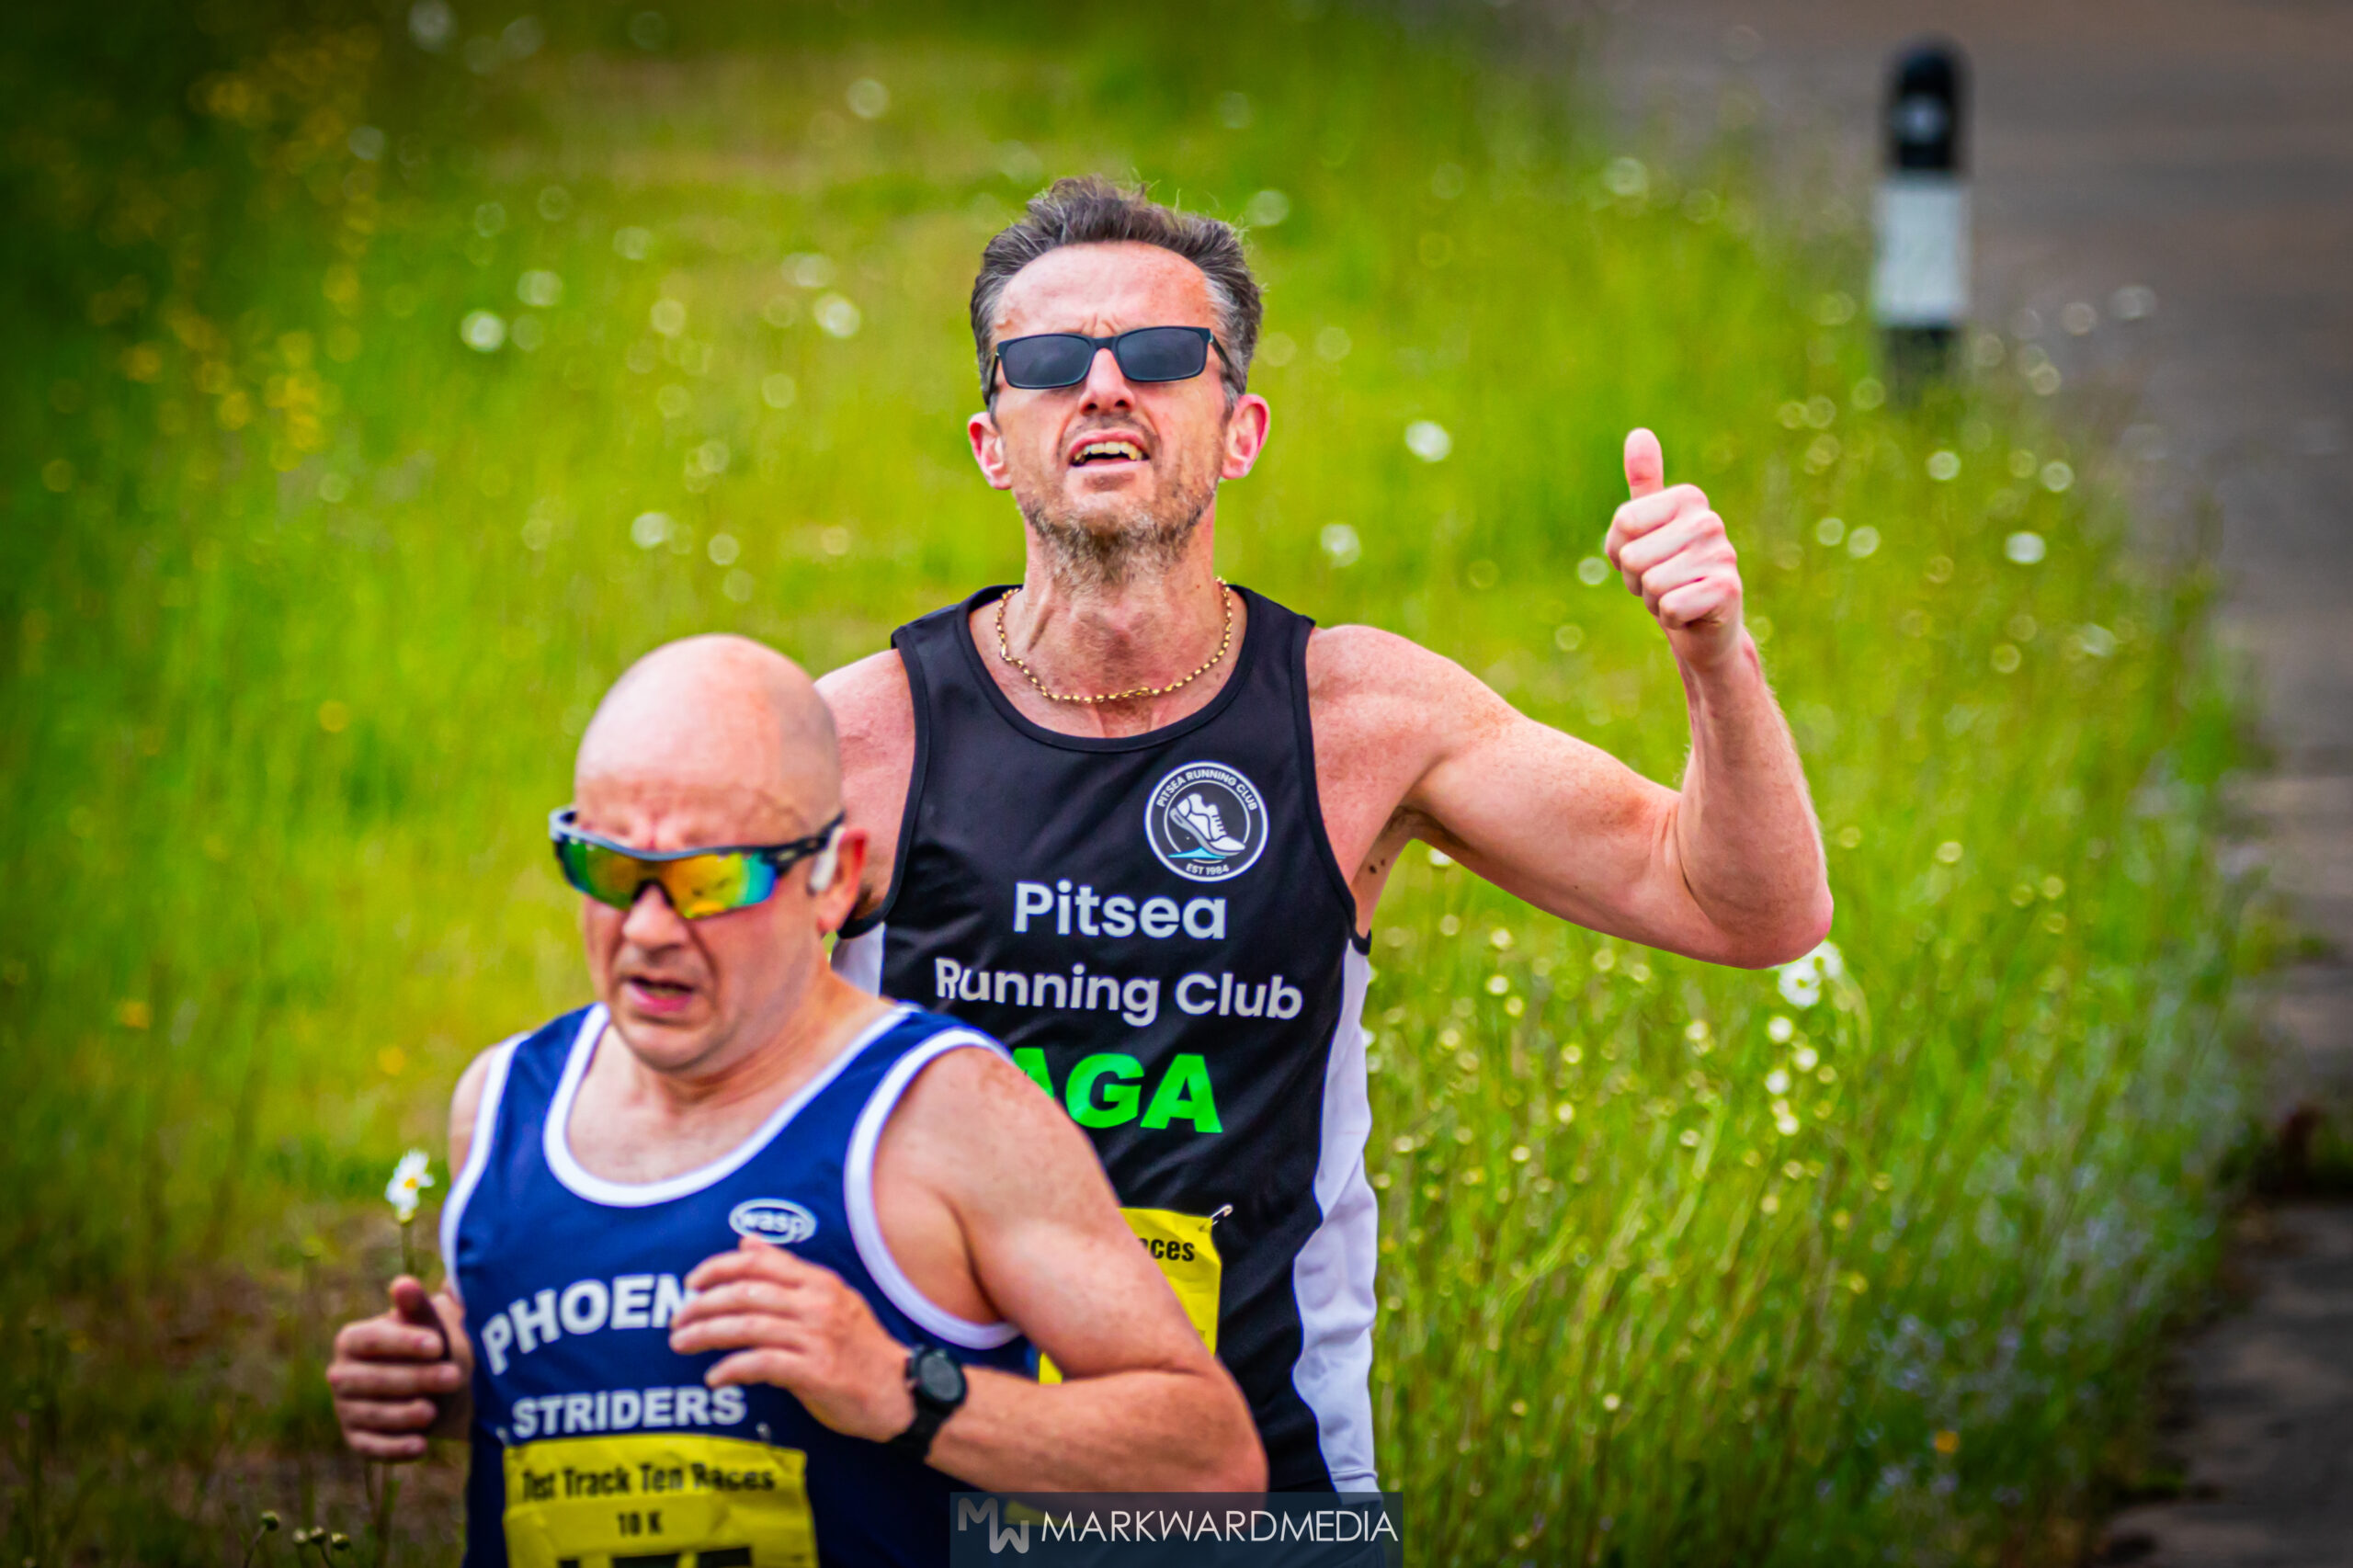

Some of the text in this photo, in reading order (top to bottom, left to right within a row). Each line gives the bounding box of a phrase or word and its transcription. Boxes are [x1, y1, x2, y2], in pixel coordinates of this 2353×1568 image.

[1156, 768, 1258, 811] PITSEA RUNNING CLUB
[1186, 863, 1230, 876] EST 1984
[1014, 880, 1227, 939] Pitsea
[935, 958, 1302, 1027] Running Club
[481, 1274, 697, 1376] PHOEN
[512, 1386, 747, 1437] STRIDERS
[564, 1465, 631, 1499] Track
[640, 1461, 684, 1492] Ten
[691, 1462, 775, 1492] Races
[617, 1511, 663, 1537] 10 K
